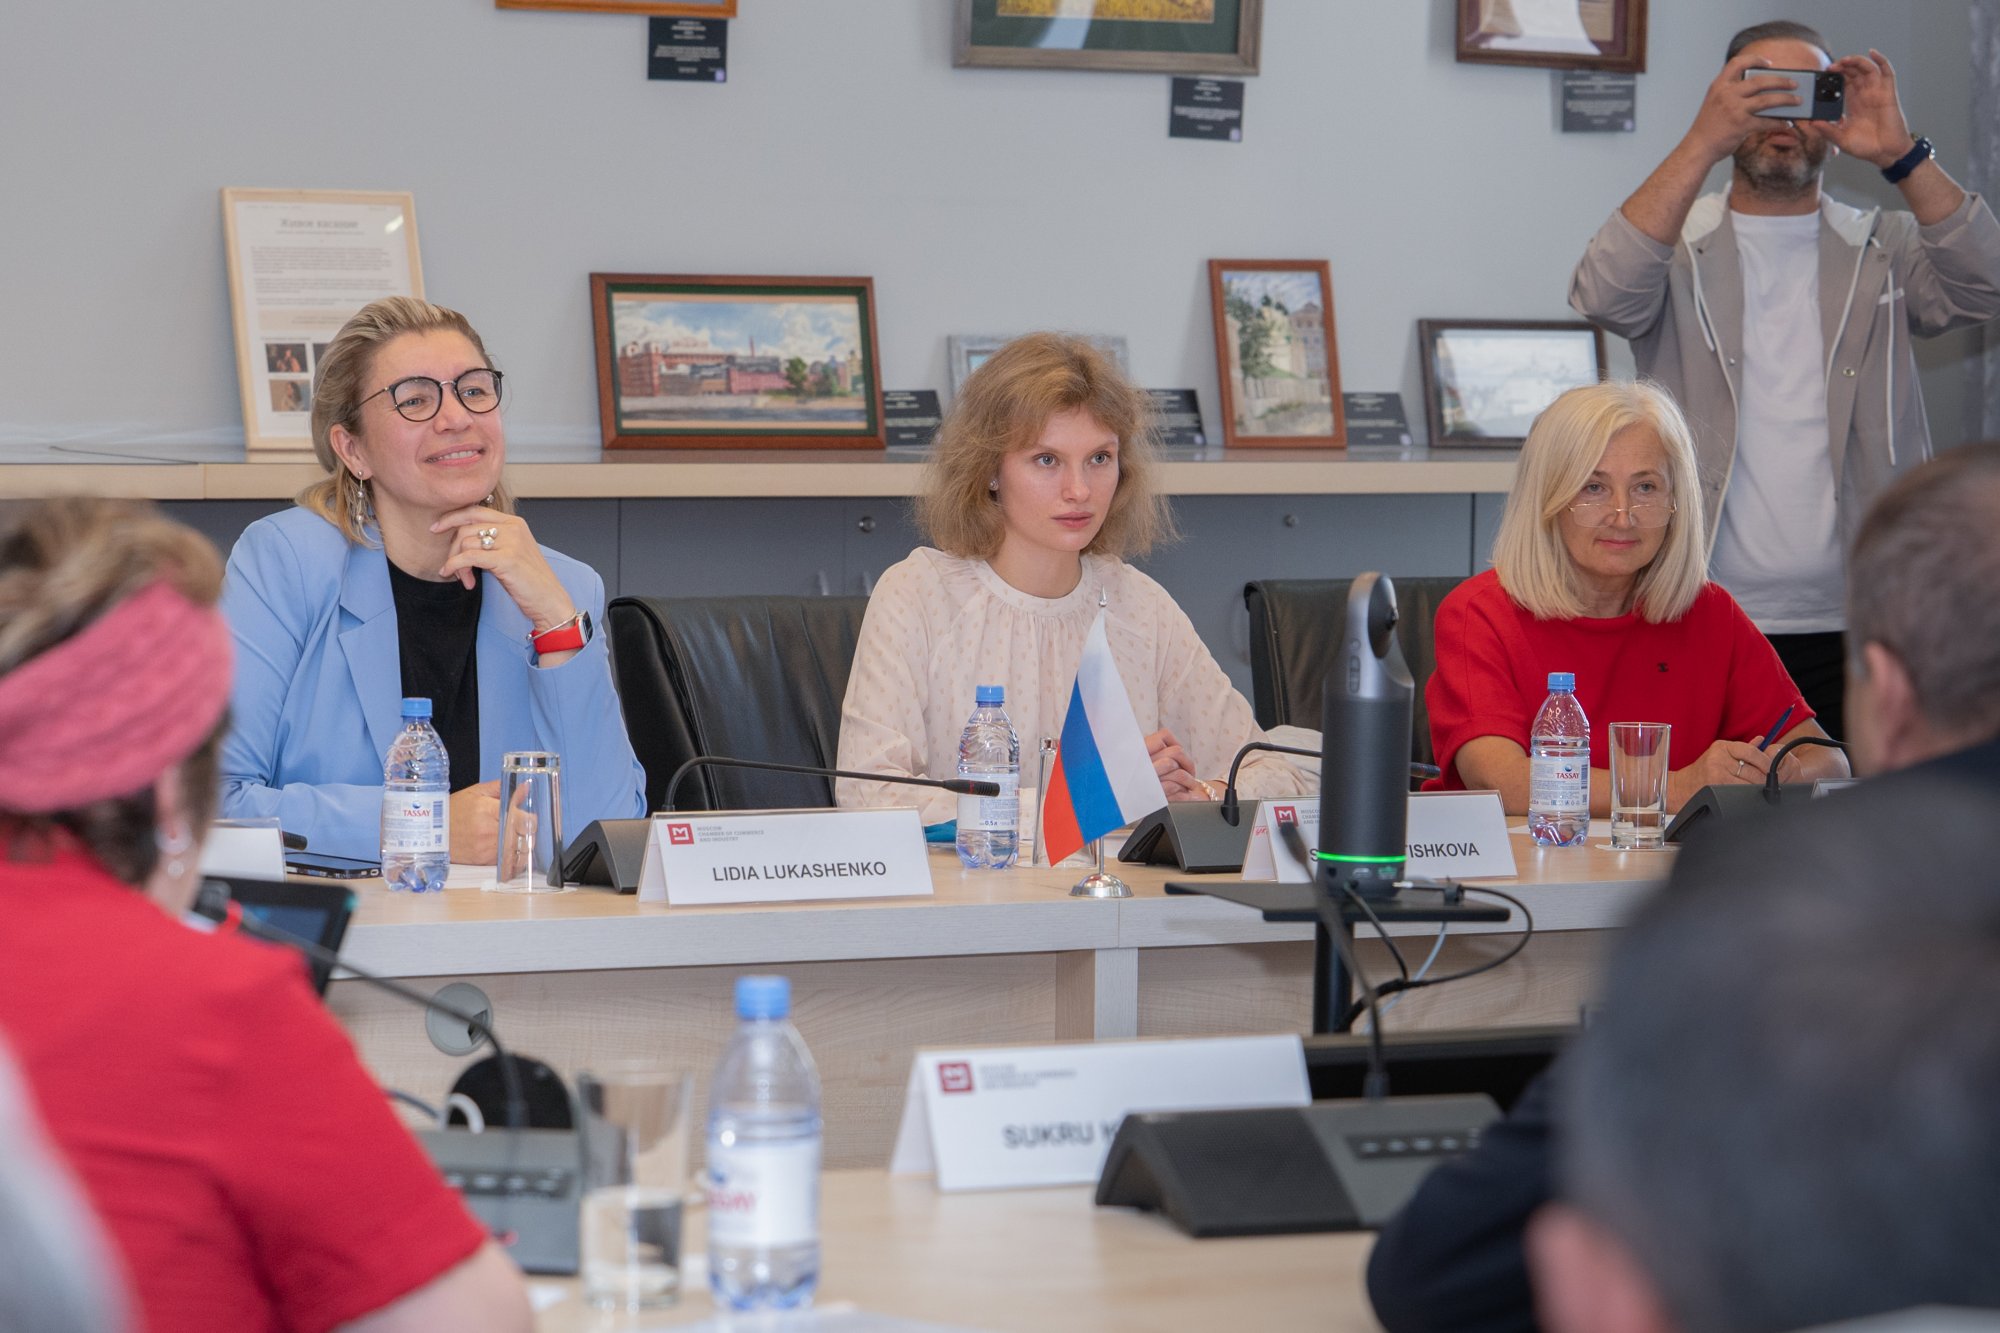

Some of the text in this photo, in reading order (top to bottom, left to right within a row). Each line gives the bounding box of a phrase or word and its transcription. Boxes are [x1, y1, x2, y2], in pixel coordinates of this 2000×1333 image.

[403, 809, 431, 817] TASSAY
[712, 861, 887, 881] LIDIA LUKASHENKO
[1001, 1122, 1096, 1149] SUKRU
